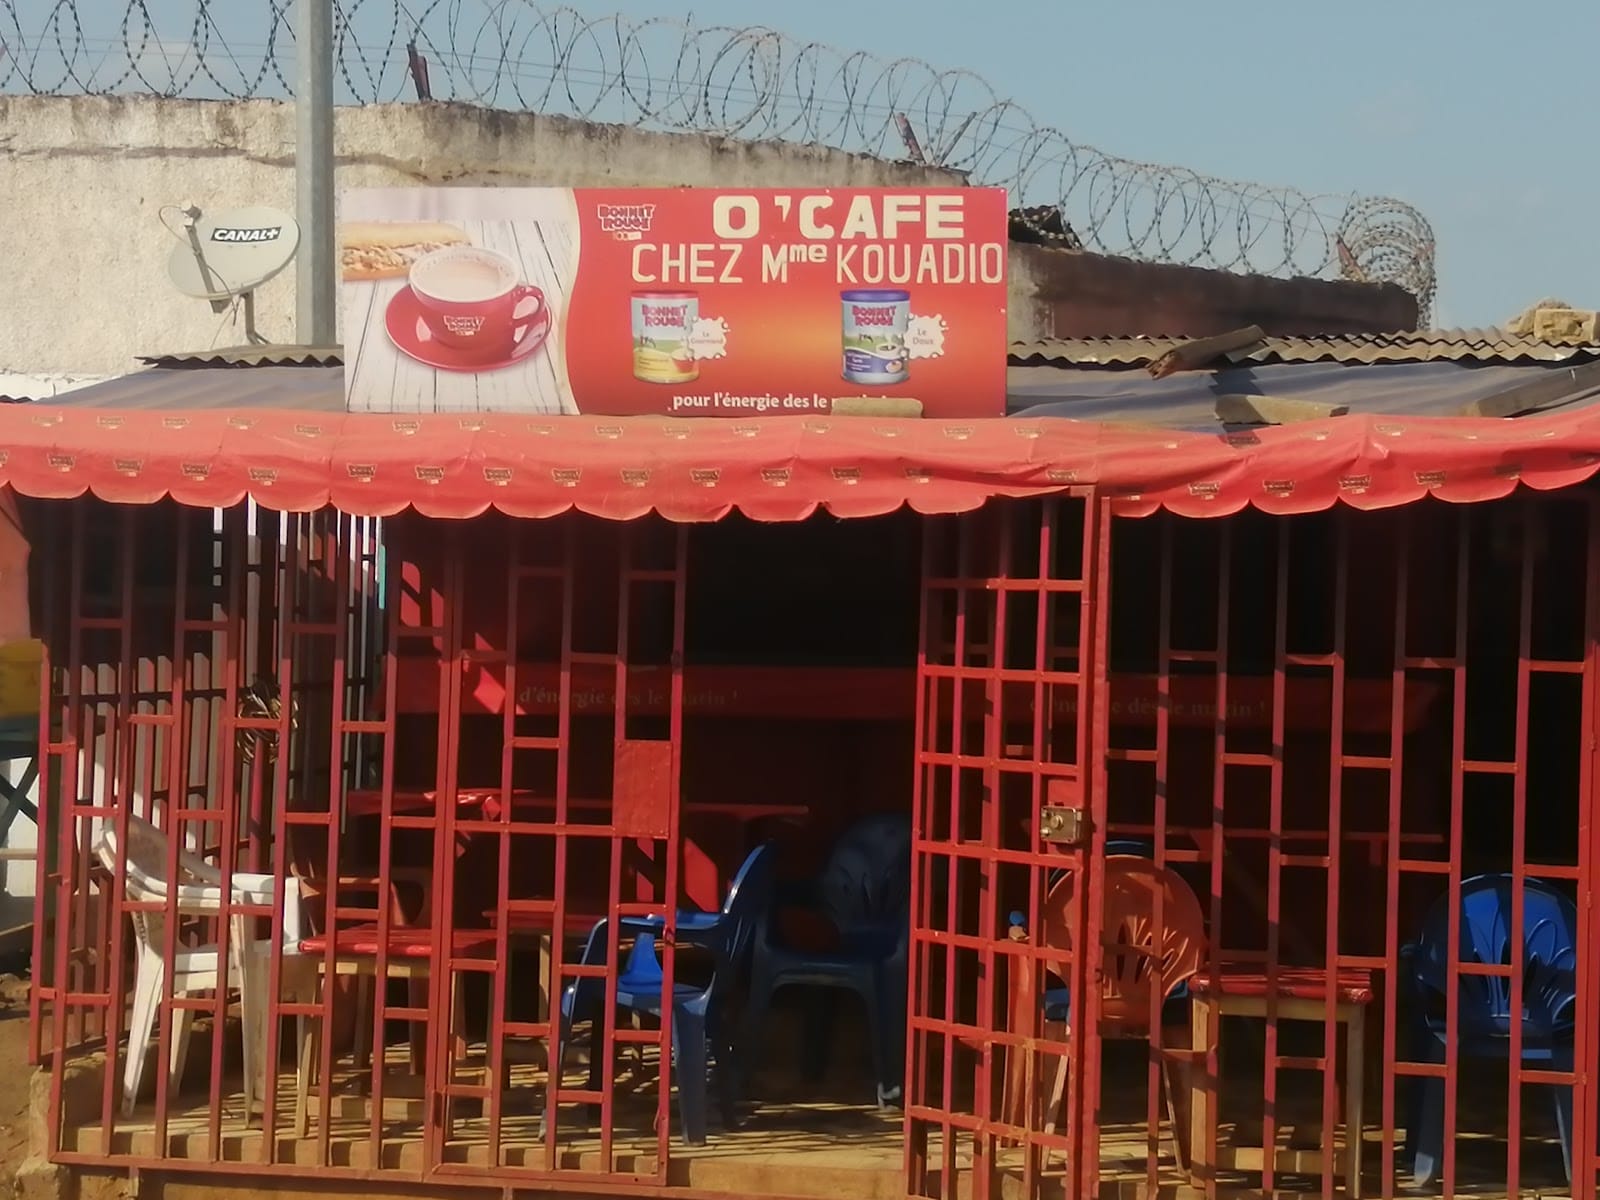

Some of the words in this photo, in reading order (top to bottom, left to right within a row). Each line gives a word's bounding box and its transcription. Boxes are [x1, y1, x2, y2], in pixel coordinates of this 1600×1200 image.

[214, 229, 279, 241] CANAL+
[631, 243, 743, 284] CHEZ
[762, 243, 828, 284] Mme
[836, 243, 1003, 284] KOUADIO
[641, 304, 688, 316] BONNET
[852, 305, 897, 317] BONNET
[673, 395, 710, 410] pour
[714, 392, 780, 411] l'énergie
[783, 393, 809, 408] des
[813, 393, 828, 408] le
